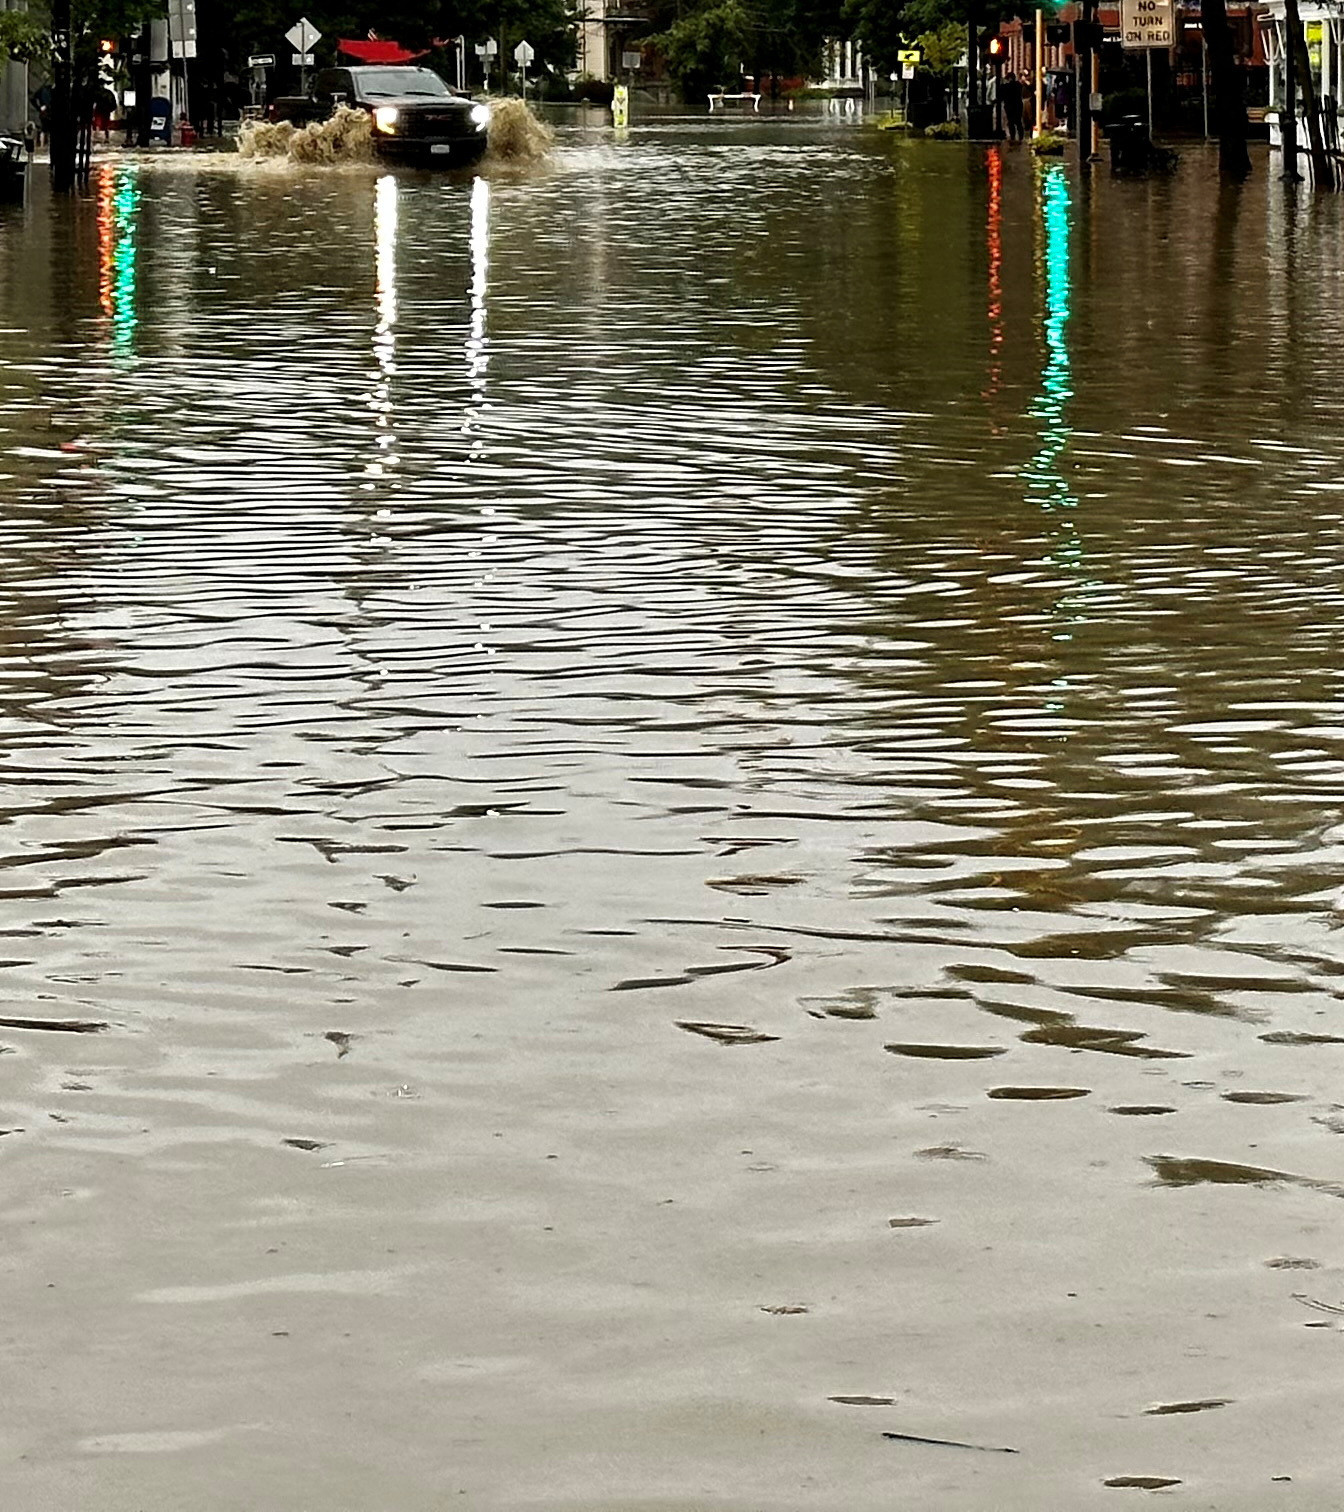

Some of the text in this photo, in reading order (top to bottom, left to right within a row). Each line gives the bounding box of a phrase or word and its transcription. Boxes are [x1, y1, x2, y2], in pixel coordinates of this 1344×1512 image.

[1138, 0, 1156, 12] NO
[1132, 15, 1163, 27] TURN
[1125, 30, 1142, 42] ON
[1146, 30, 1171, 42] RED
